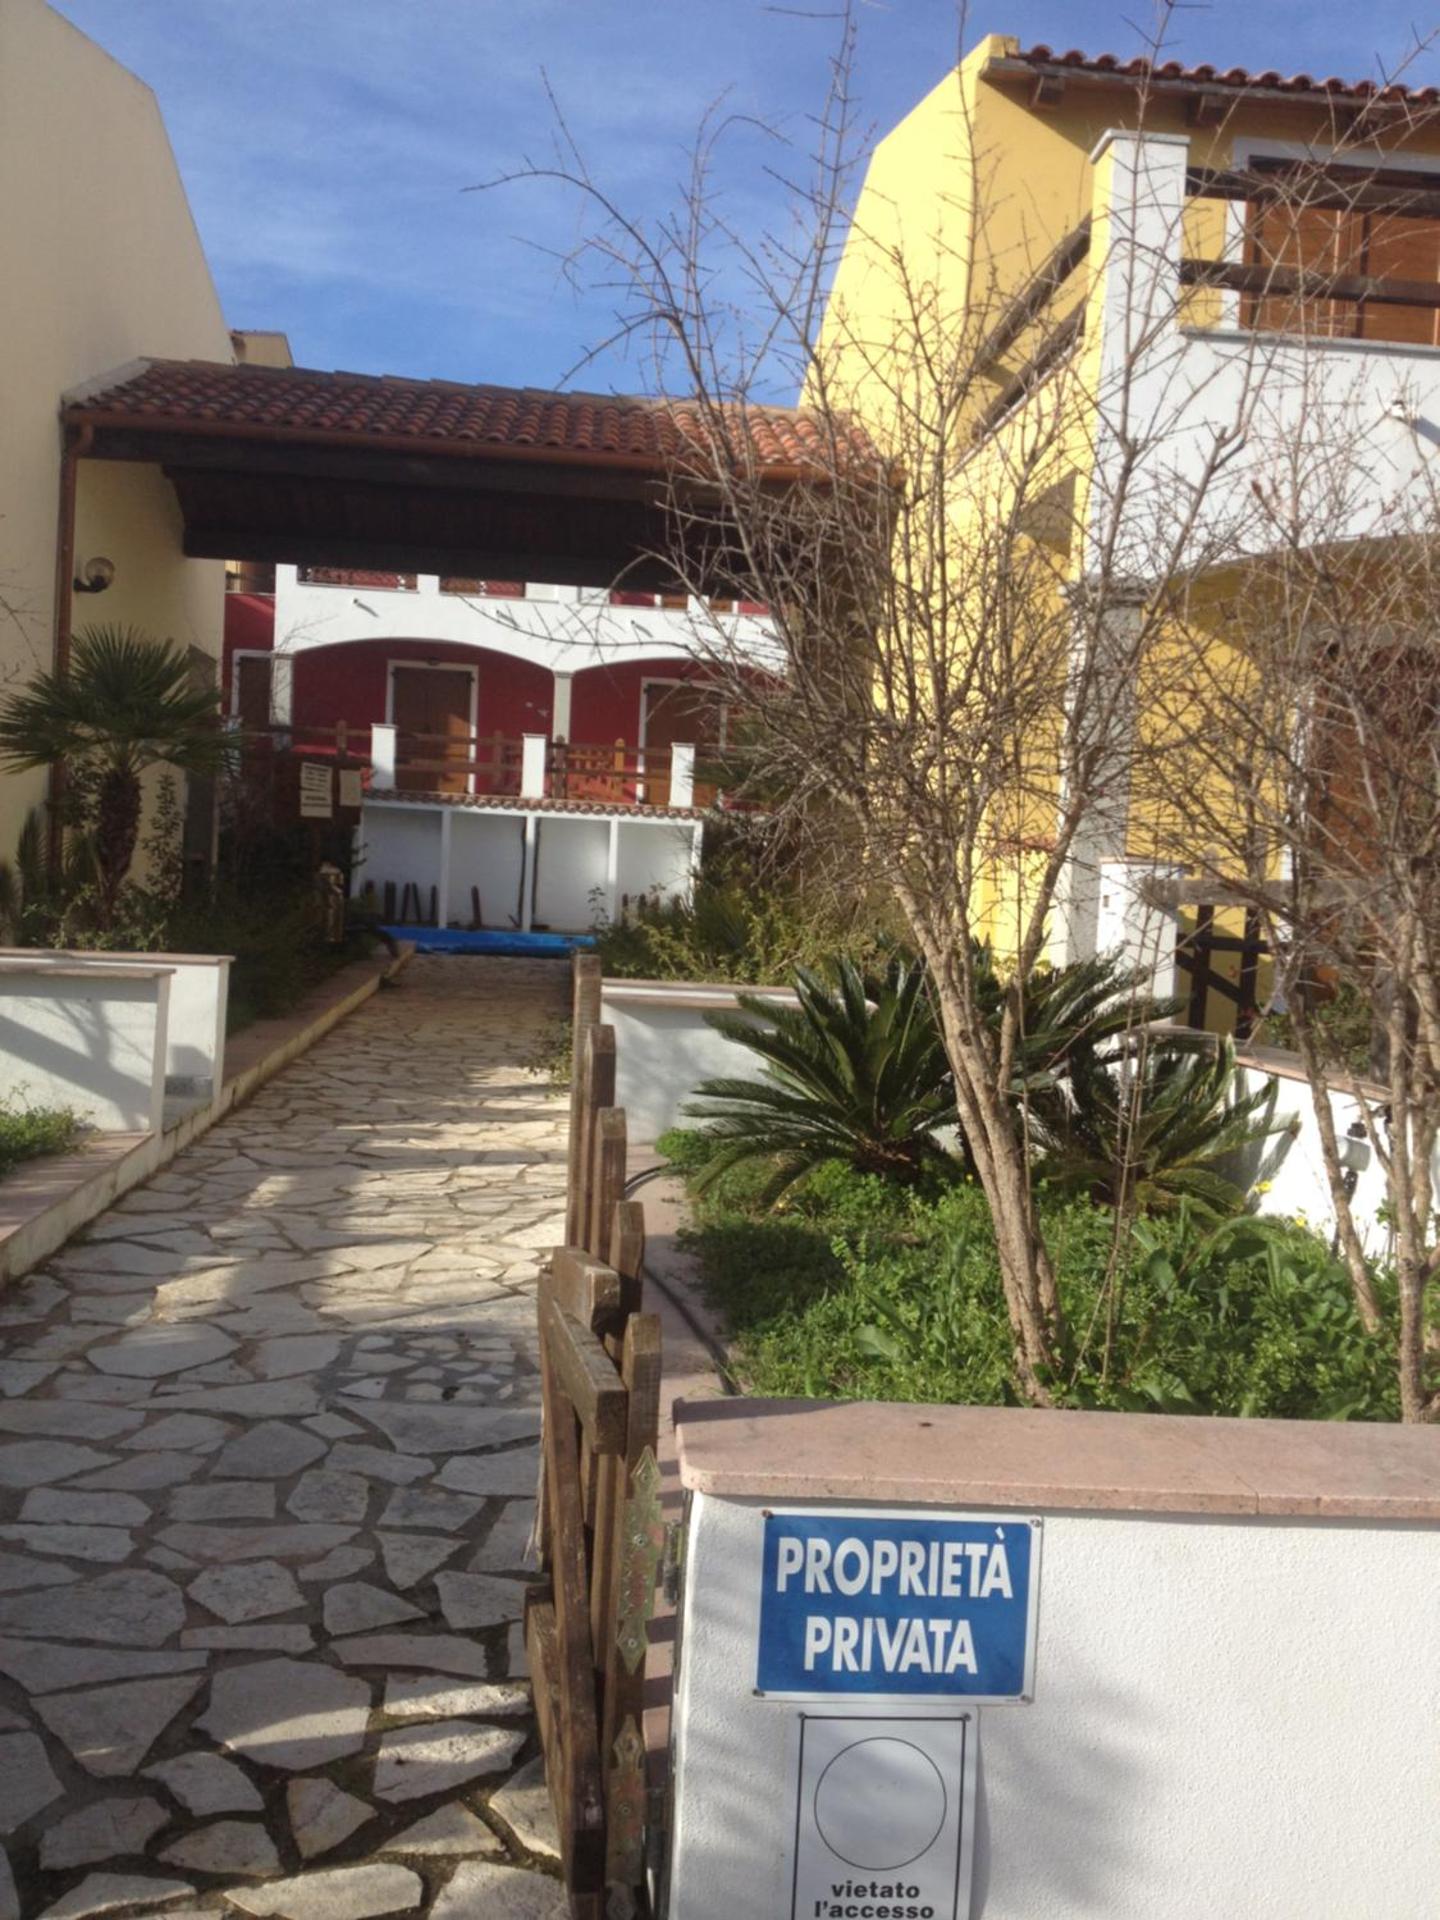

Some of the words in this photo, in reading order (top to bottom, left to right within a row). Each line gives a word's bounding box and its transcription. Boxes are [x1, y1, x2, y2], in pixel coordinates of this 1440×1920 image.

[776, 1526, 1014, 1600] PROPRIETÀ
[803, 1616, 979, 1675] PRIVATA
[831, 1880, 920, 1898] vietato
[814, 1900, 934, 1919] l'accesso
